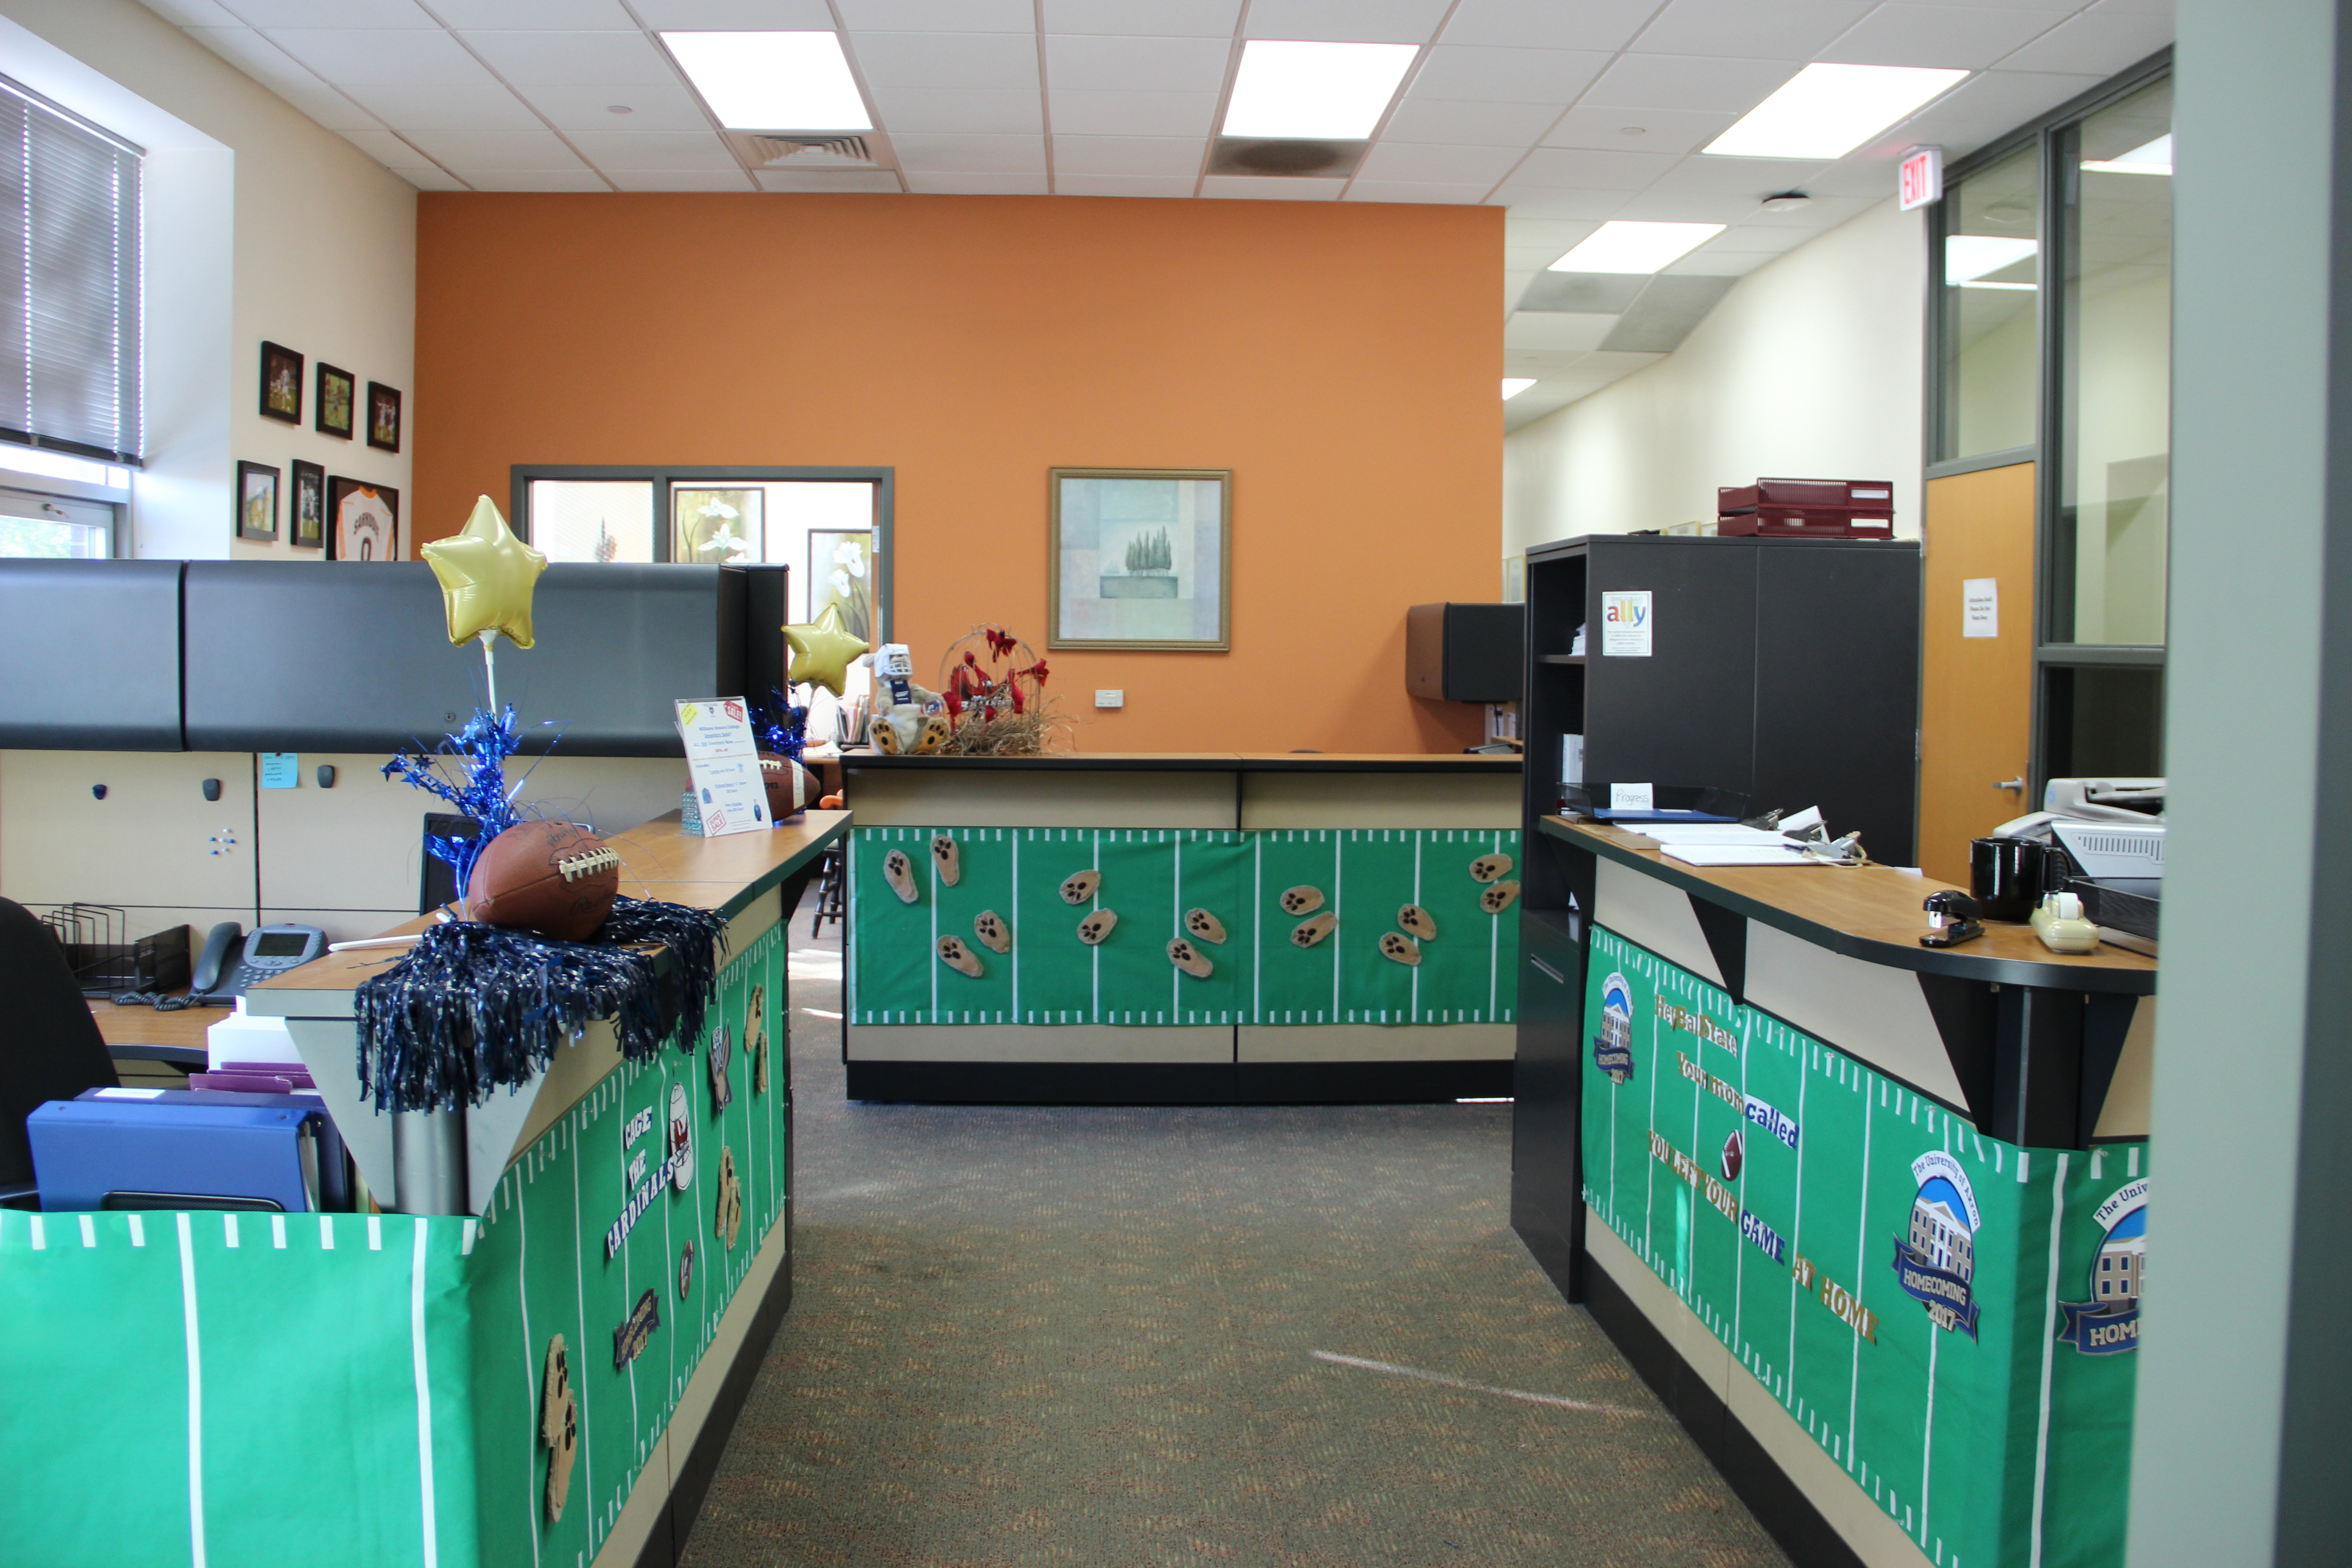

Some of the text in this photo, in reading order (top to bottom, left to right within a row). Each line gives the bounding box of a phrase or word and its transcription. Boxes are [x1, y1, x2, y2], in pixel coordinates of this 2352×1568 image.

[1903, 155, 1926, 204] EXIT
[1607, 600, 1646, 627] ally
[1616, 789, 1649, 806] Progress
[1655, 994, 1738, 1058] Hey Ball State
[1677, 1050, 1799, 1150] Your mom called
[625, 1106, 652, 1150] CAGE
[628, 1148, 646, 1191] THE
[1913, 1161, 1925, 1176] The
[1925, 1154, 1959, 1179] University
[1964, 1186, 1979, 1226] Akron
[608, 1155, 674, 1259] CARDINALS
[2096, 1200, 2119, 1221] The
[1648, 1129, 1879, 1345] YOU LEFT YOUR GAME AT HOME
[1903, 1268, 1967, 1306] HOMECOMING
[1928, 1299, 1956, 1332] 2017
